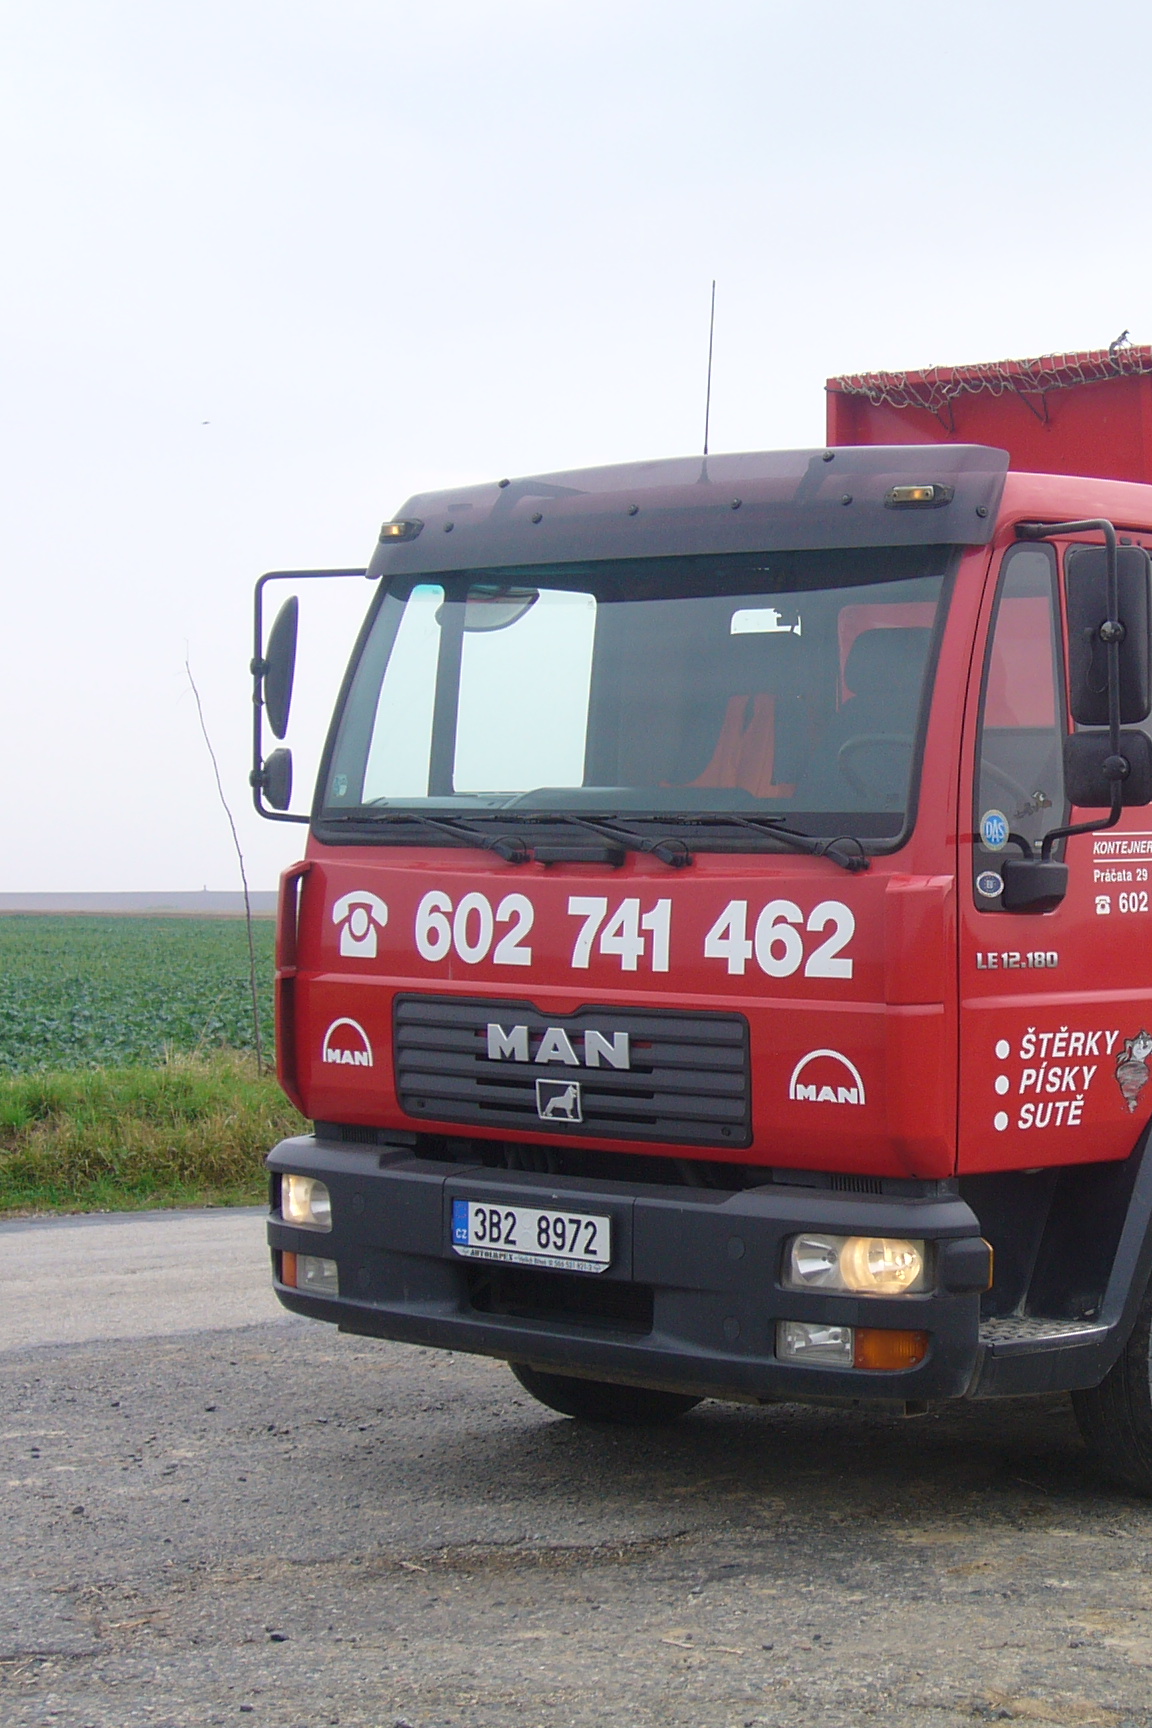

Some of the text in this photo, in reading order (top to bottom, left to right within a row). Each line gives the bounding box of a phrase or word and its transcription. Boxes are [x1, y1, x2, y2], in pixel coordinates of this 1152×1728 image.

[1093, 868, 1132, 883] Práčata
[1136, 868, 1148, 881] 29
[1119, 891, 1148, 913] 602
[415, 889, 856, 979] 602 741 462
[976, 951, 1059, 970] LE 12.180
[487, 1023, 630, 1070] MAN
[1019, 1026, 1120, 1060] ŠTĚRKY
[326, 1048, 369, 1067] MAN
[1018, 1061, 1097, 1095] PÍSKY
[796, 1084, 859, 1104] MAN
[1017, 1094, 1085, 1130] SUTĚ
[455, 1228, 468, 1240] CZ
[474, 1207, 598, 1256] 3B2 8972
